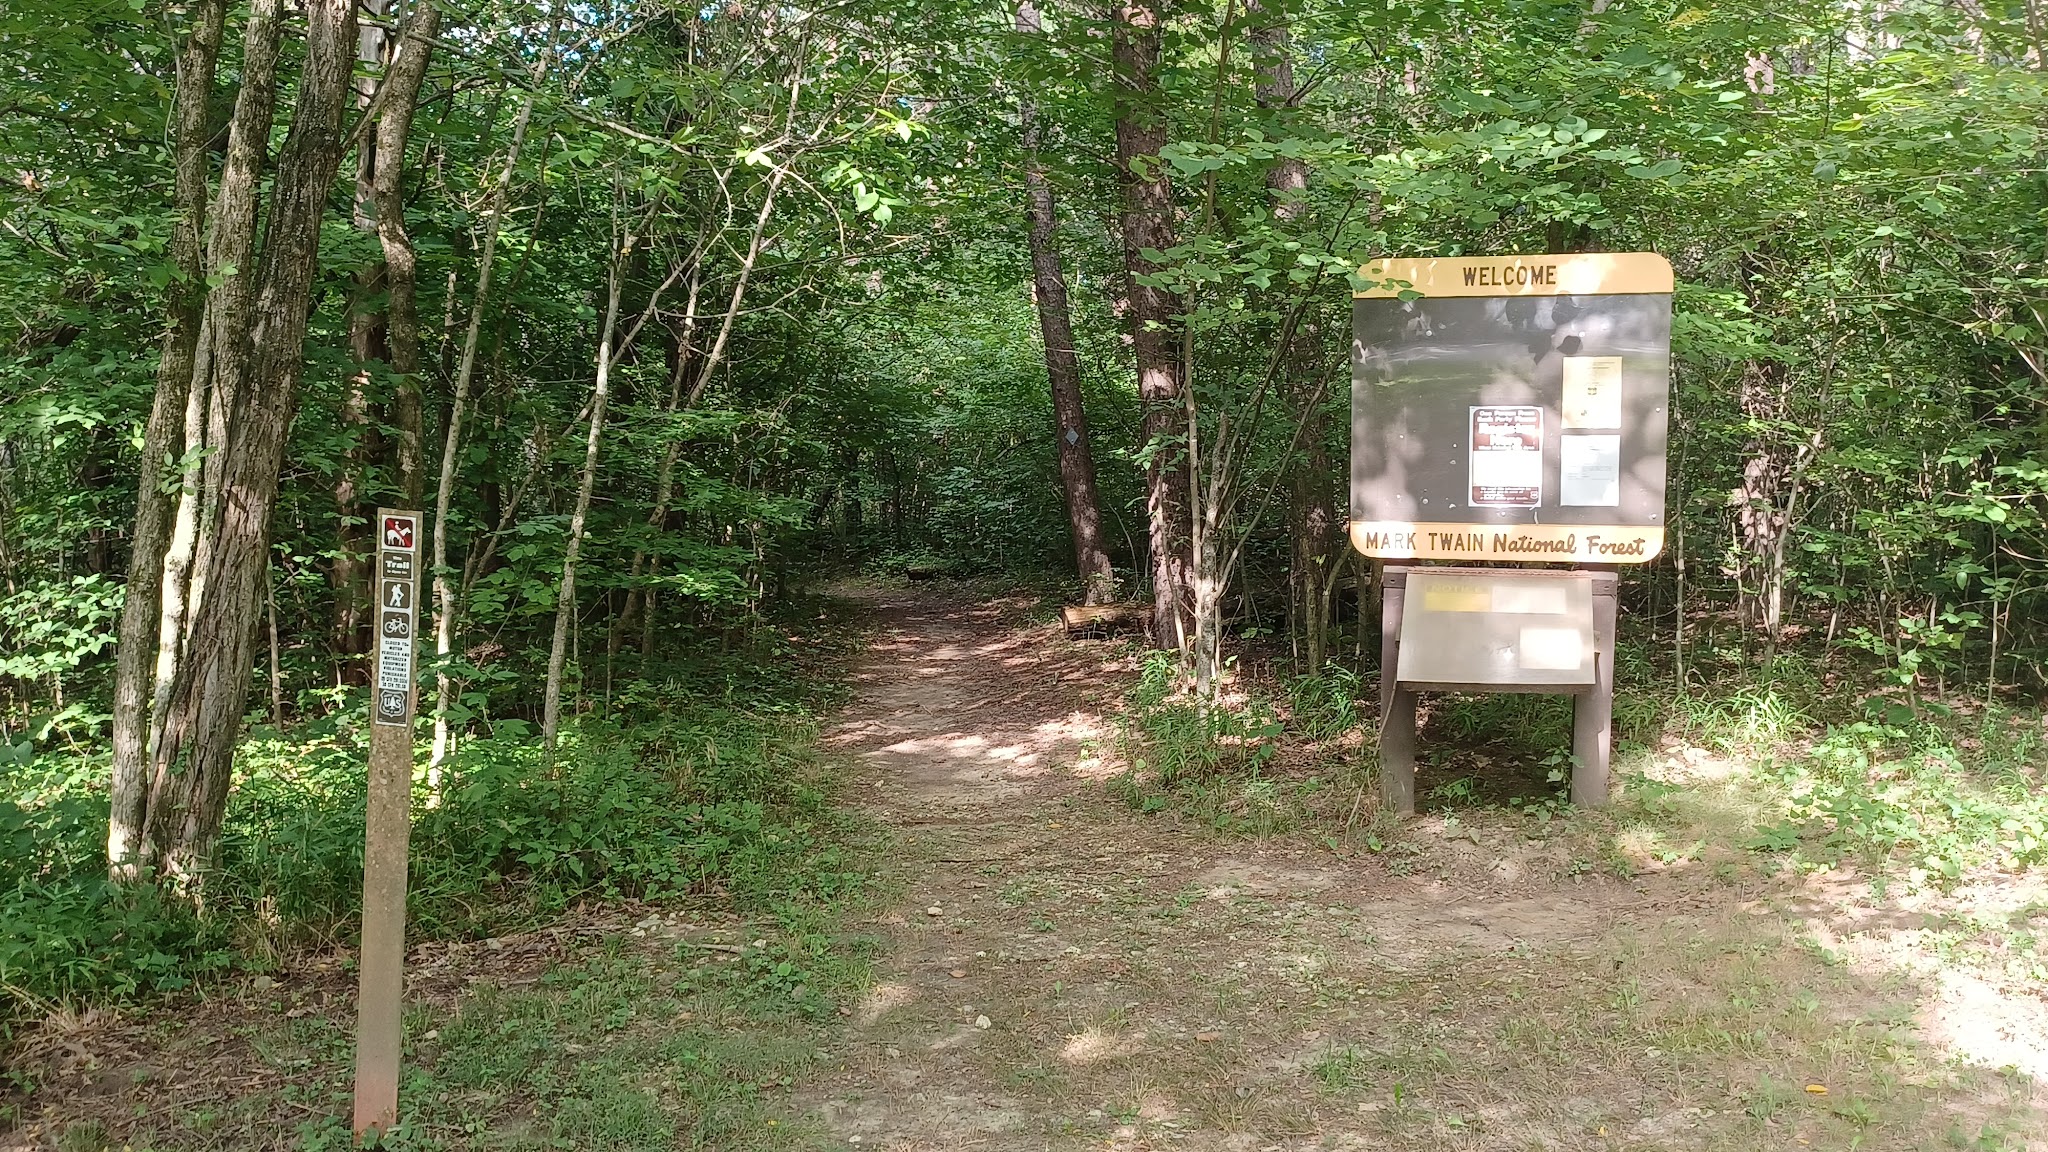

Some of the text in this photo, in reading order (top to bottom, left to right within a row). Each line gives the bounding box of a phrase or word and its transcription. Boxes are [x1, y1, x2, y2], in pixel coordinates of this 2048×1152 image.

[1463, 264, 1557, 287] WELCOME
[1366, 531, 1646, 556] MARK TWAIN National Forest
[385, 560, 410, 569] Trail
